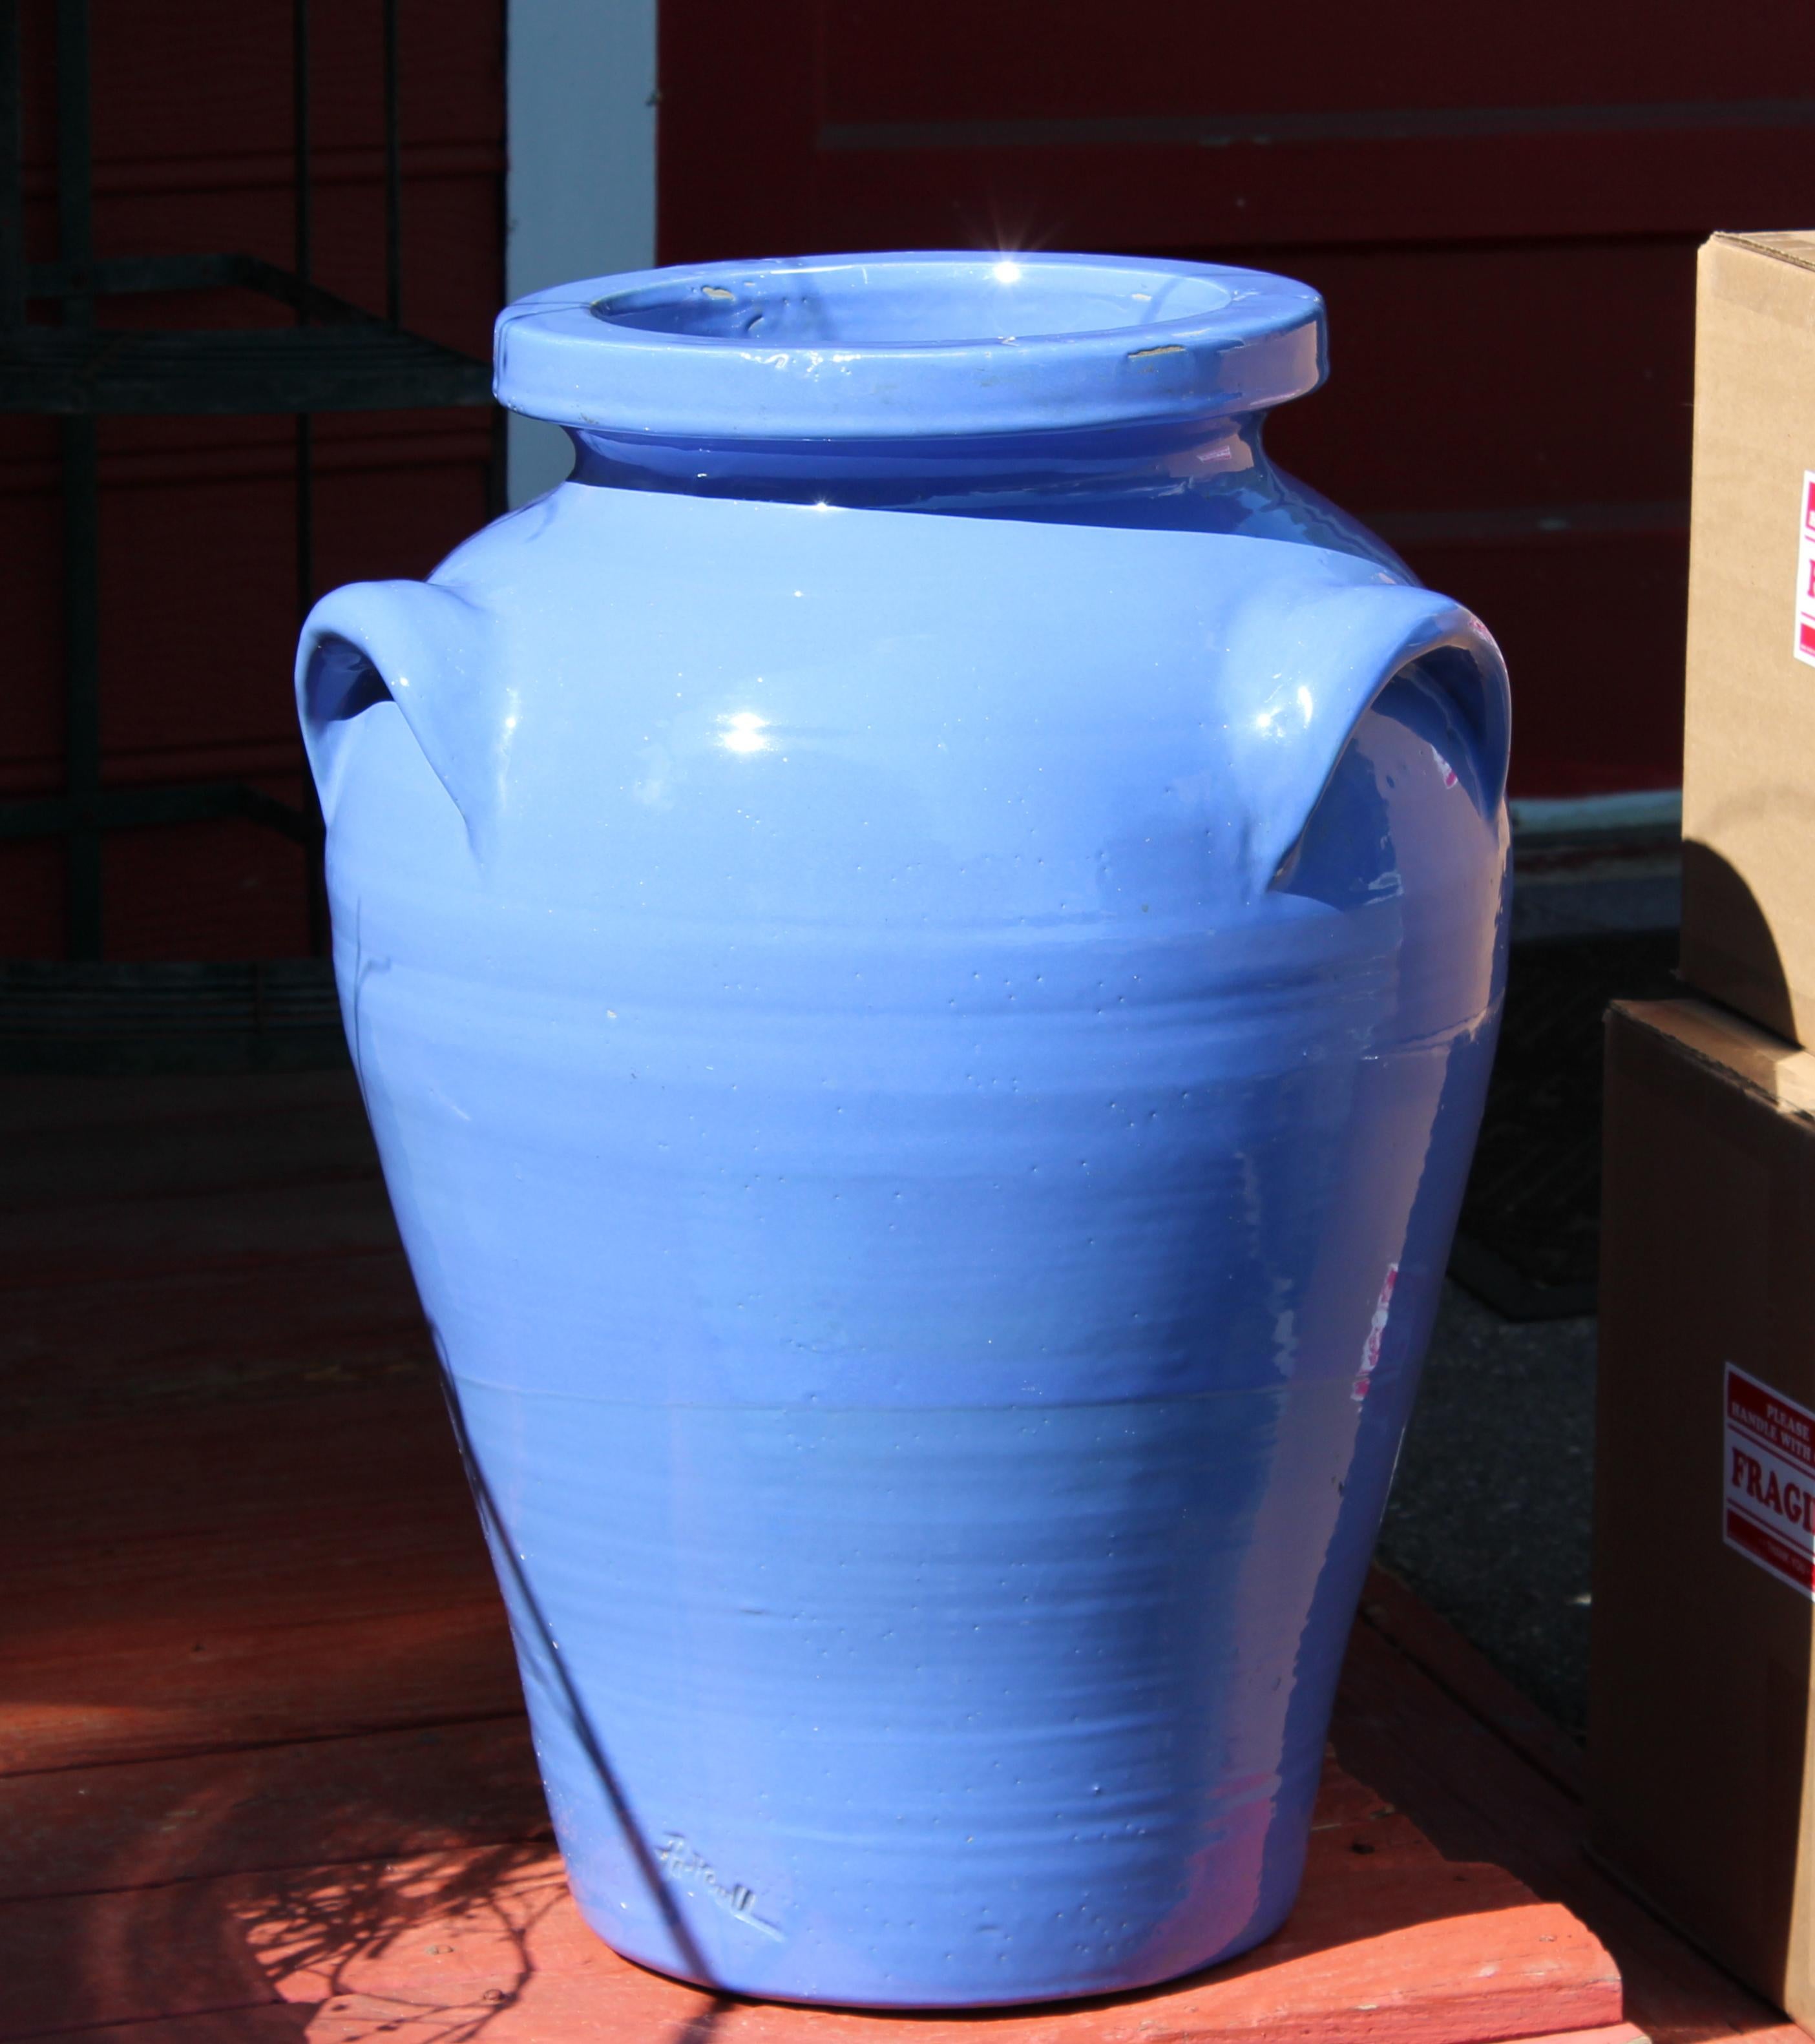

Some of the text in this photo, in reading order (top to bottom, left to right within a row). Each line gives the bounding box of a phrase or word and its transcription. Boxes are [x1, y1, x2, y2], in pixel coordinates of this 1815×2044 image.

[1732, 1401, 1810, 1462] HANDLE WITH
[1767, 1404, 1809, 1440] PLEASE
